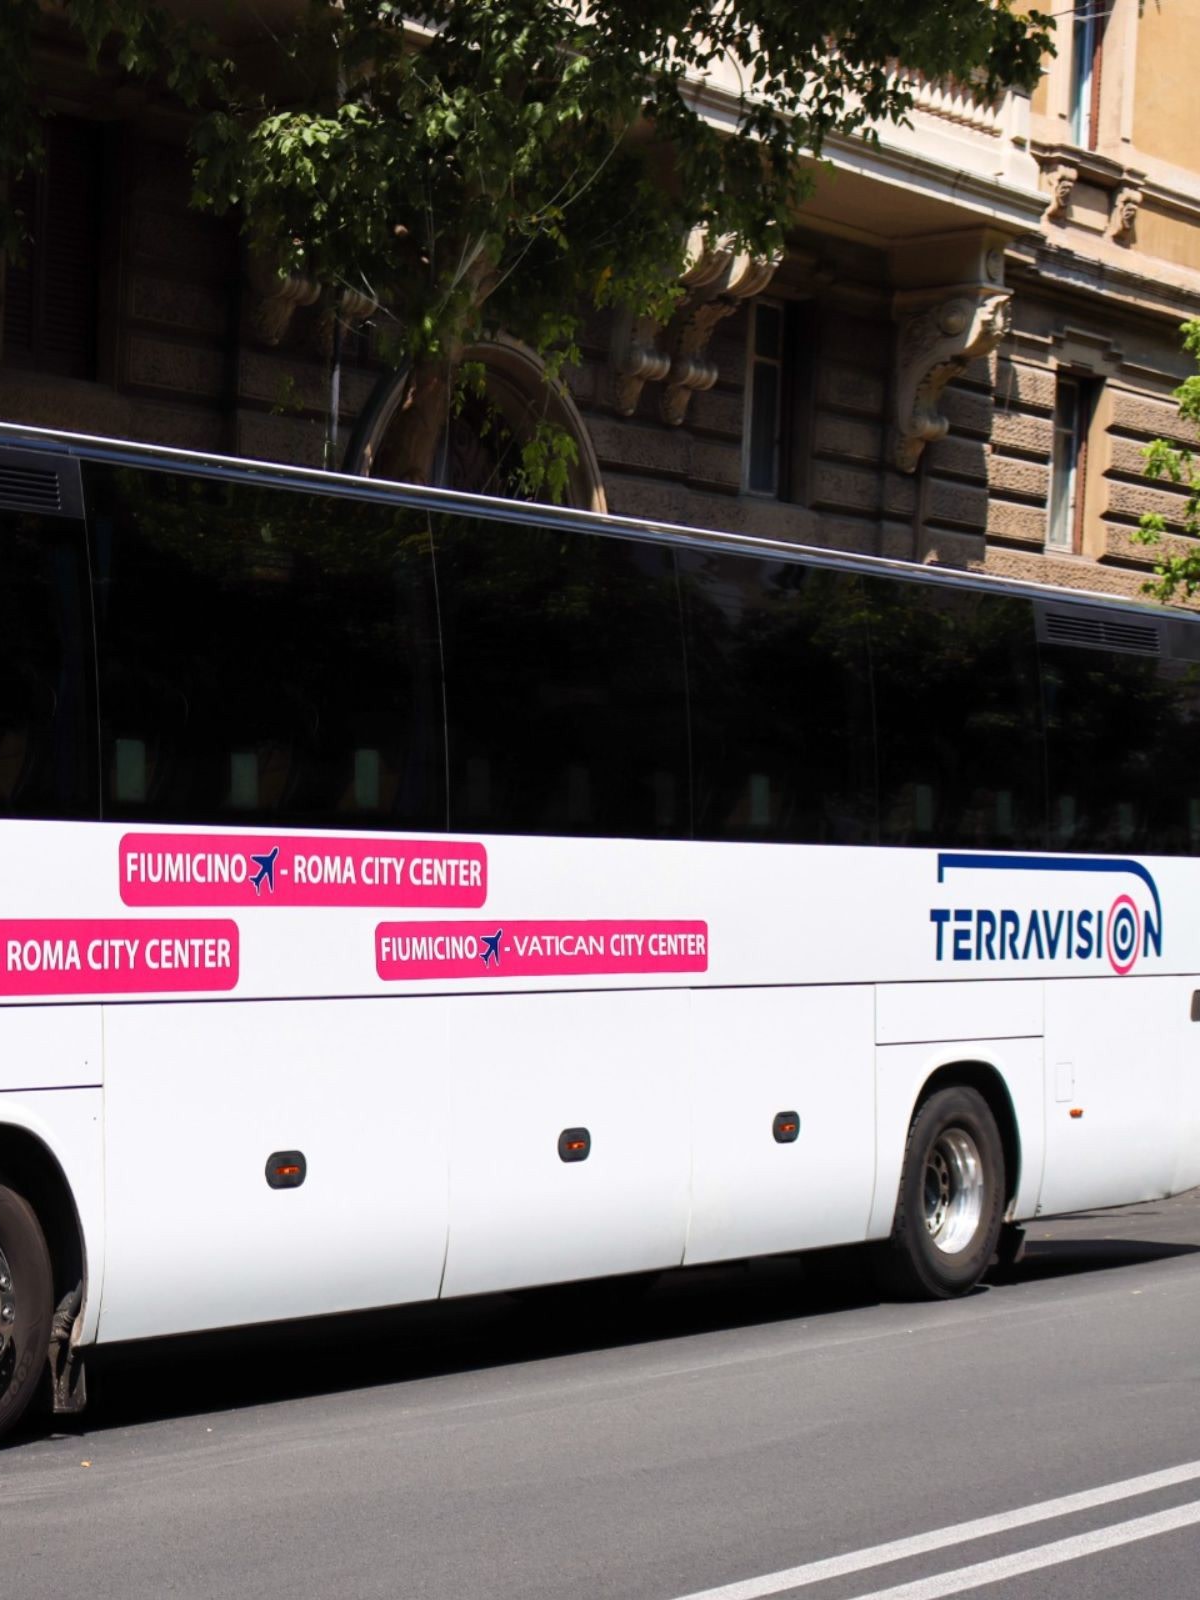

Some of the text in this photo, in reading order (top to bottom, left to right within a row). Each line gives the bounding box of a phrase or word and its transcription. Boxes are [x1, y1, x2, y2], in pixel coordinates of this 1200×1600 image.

[126, 852, 247, 884] FIUMICINO
[294, 854, 356, 885] ROMA
[361, 856, 405, 885] CITY
[409, 857, 482, 887] CENTER
[381, 936, 478, 962] FIUMICINO
[513, 935, 605, 957] VATICAN
[609, 933, 645, 957] CITY
[648, 933, 706, 957] CENTER
[930, 895, 1163, 974] TERRAVISION
[6, 939, 81, 972] ROMA
[86, 939, 140, 970] CITY
[145, 938, 232, 970] CENTER
